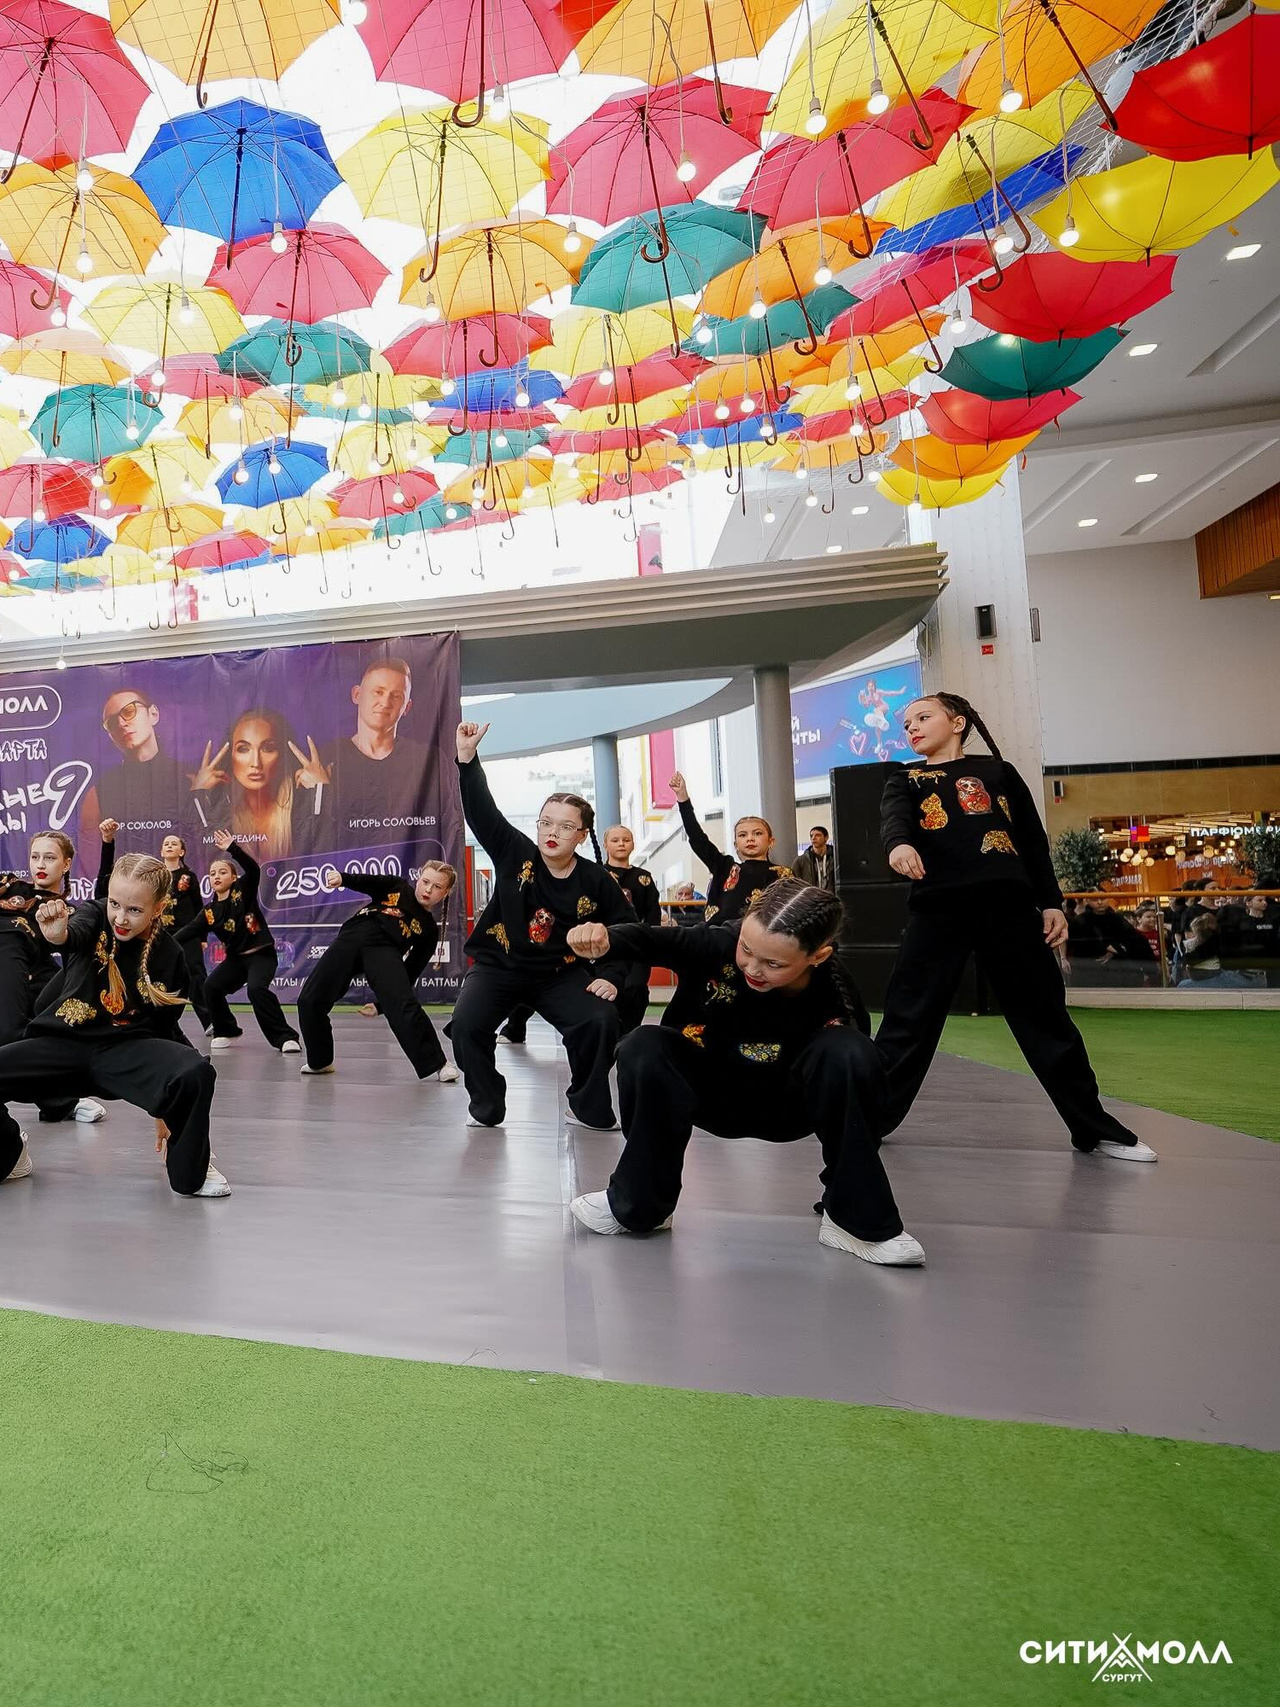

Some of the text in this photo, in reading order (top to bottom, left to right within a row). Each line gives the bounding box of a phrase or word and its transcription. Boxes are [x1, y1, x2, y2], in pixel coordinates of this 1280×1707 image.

[792, 729, 821, 746] ЧТЫ
[126, 820, 172, 830] СОКОЛОВ
[349, 816, 436, 829] ИГОРЬ СОЛОВЬЕВ
[232, 834, 268, 843] РЕДИНА
[270, 977, 298, 987] АТТЛЫ
[421, 977, 459, 987] БАТТЛЫ
